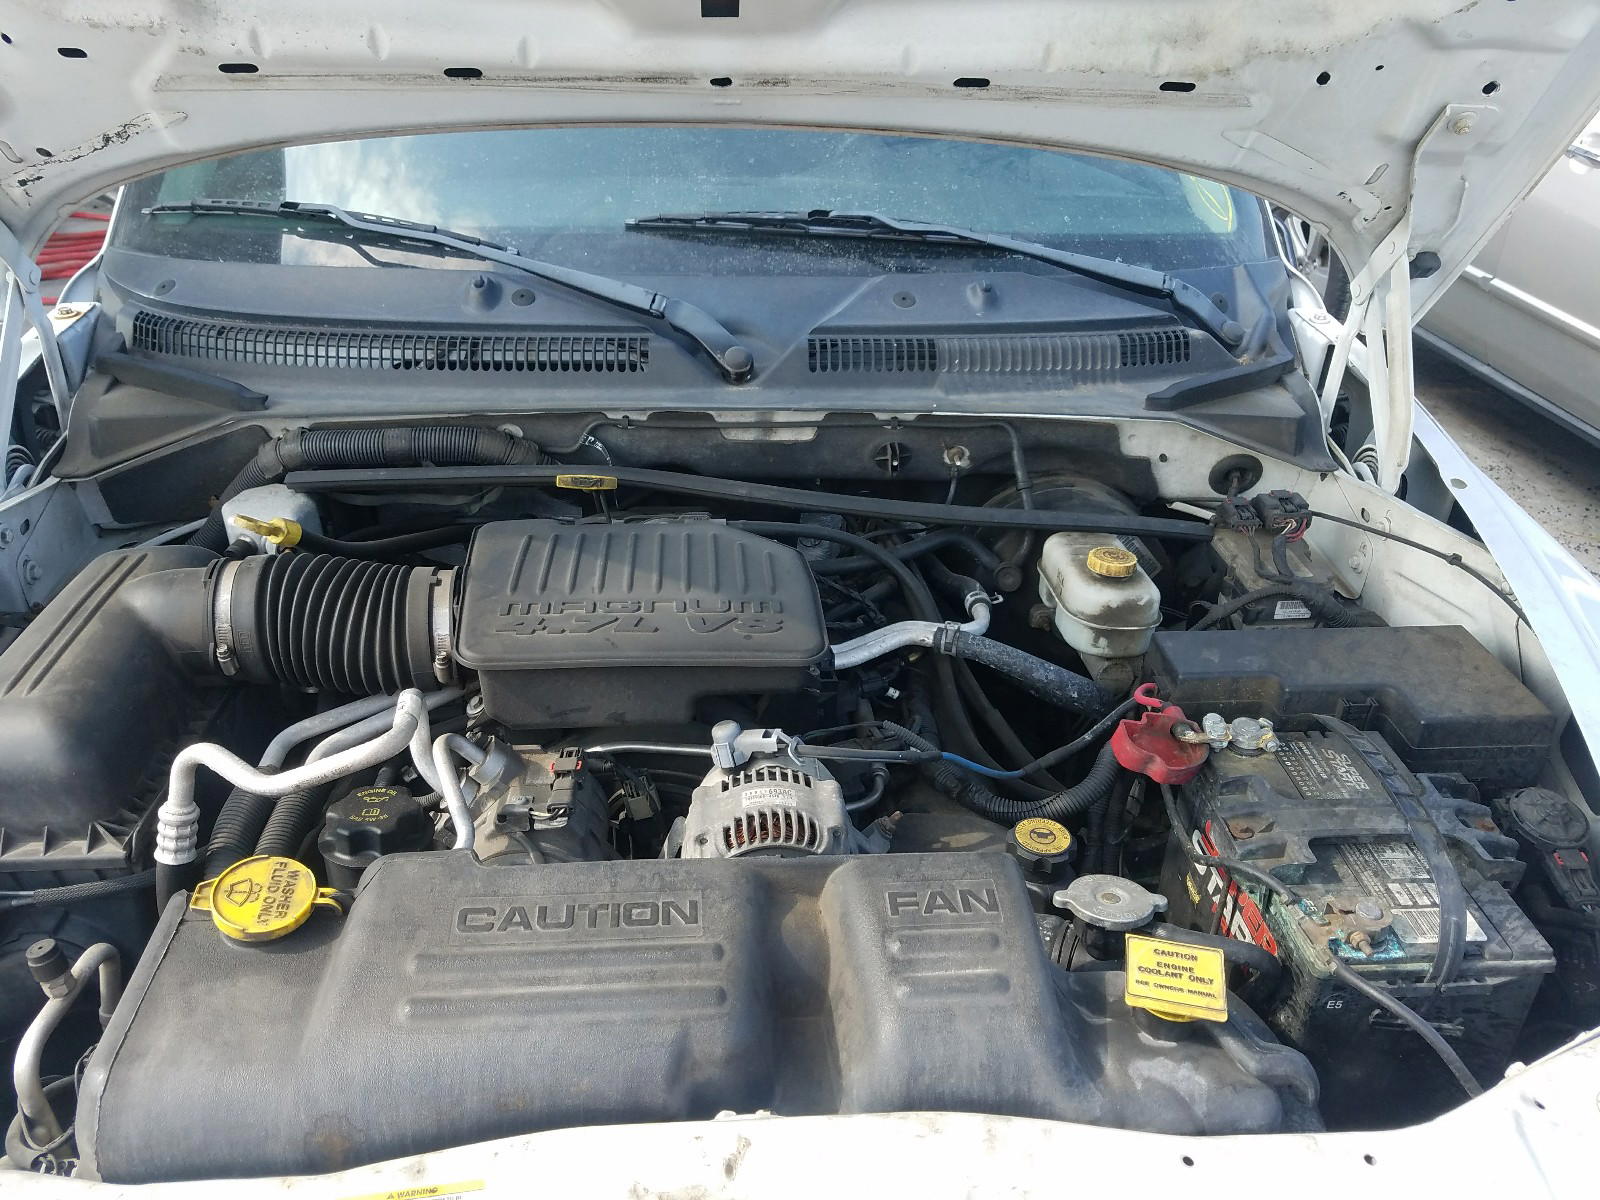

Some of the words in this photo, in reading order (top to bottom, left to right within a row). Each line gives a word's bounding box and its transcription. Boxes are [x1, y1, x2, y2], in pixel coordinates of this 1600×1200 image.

[499, 600, 784, 616] MAGNUM
[685, 616, 784, 635] V8
[1321, 748, 1361, 791] START
[1340, 753, 1370, 790] SUPER
[356, 788, 386, 797] ENGINE
[266, 861, 288, 894] FLUID
[274, 869, 301, 919] WASHER
[257, 896, 278, 927] ONLY
[456, 900, 699, 934] CAUTION
[886, 888, 1000, 917] FAN
[1153, 948, 1198, 961] CAUTION
[1138, 965, 1184, 979] COOLANT
[1188, 974, 1214, 985] ONLY
[1156, 961, 1195, 973] ENGINE
[1326, 1000, 1344, 1009] E5
[397, 1187, 438, 1199] WARNING
